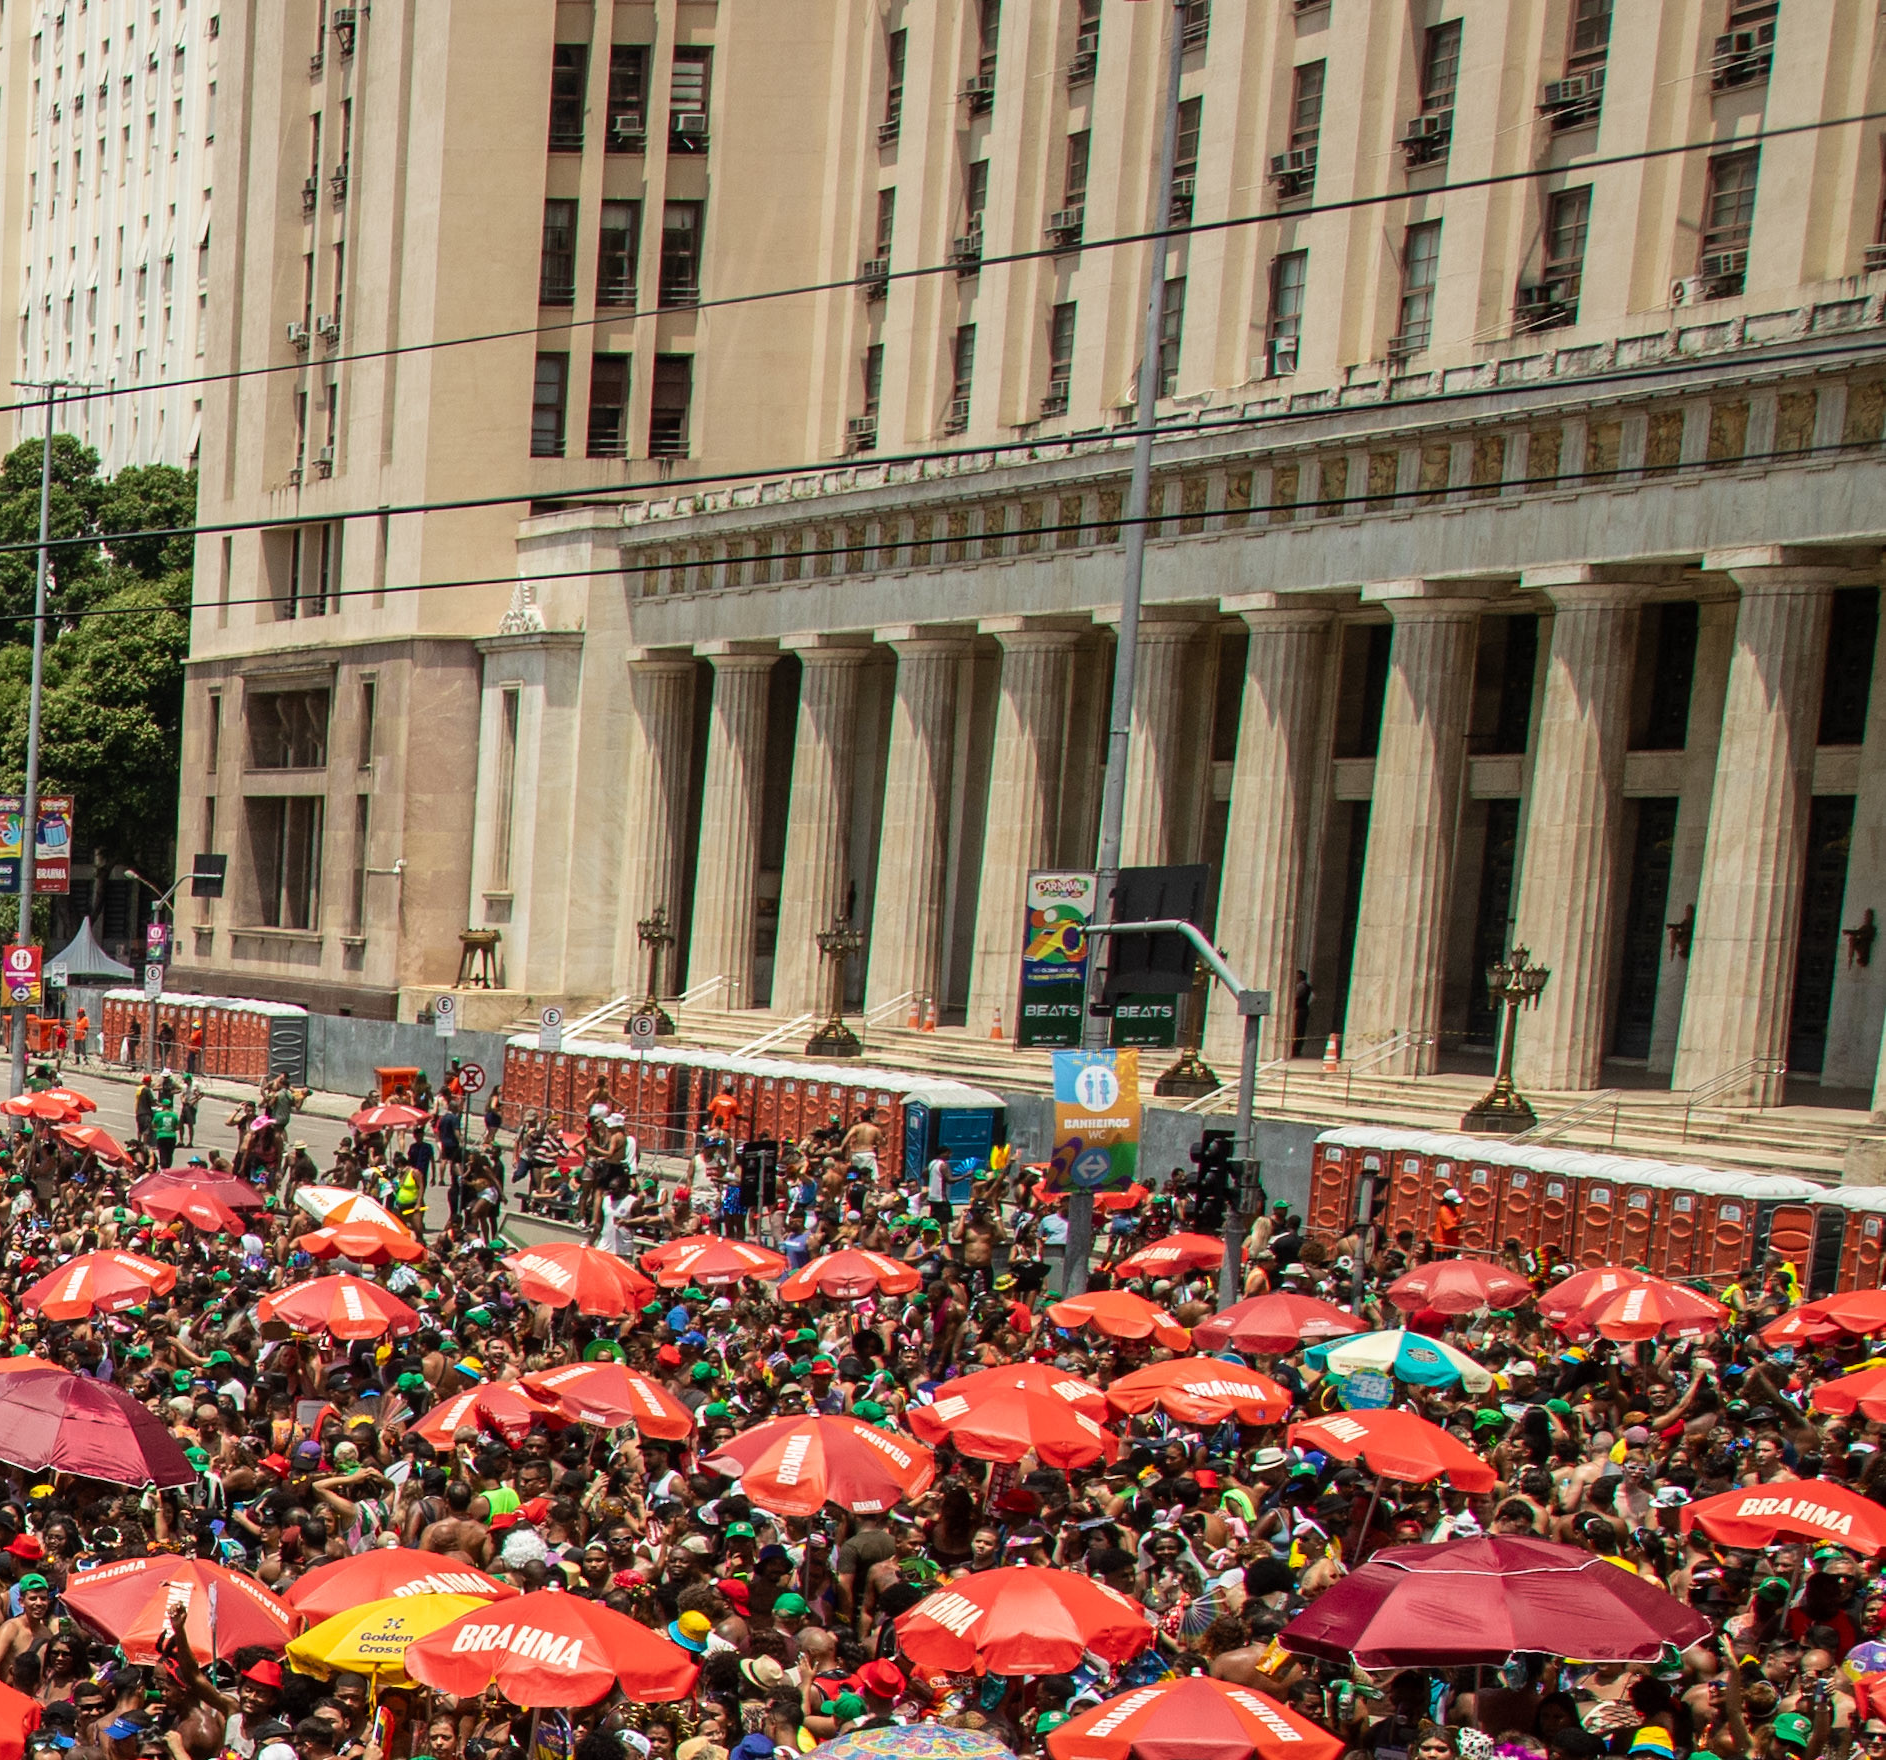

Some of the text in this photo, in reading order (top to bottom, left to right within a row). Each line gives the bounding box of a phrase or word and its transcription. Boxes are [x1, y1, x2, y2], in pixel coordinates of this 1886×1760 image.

[37, 868, 66, 879] BRAHMA
[1036, 879, 1088, 893] CARNAVAL
[1025, 1005, 1080, 1017] BEATS
[1117, 1005, 1172, 1018] BEATS
[1088, 1130, 1106, 1139] WC
[309, 1192, 330, 1208] vivo
[63, 1264, 91, 1301] BRAHMA
[518, 1254, 572, 1288] BRAHMA
[270, 1280, 316, 1306] BRAHMA
[341, 1286, 361, 1321] BRAHMA
[541, 1366, 596, 1387] BRAHMA
[629, 1378, 667, 1417] BRAHMA
[1181, 1382, 1267, 1402] BRAHMA
[440, 1394, 478, 1430] BRAHMA
[778, 1435, 811, 1486] BRAHMA
[853, 1425, 911, 1469] BRAHMA
[1736, 1497, 1855, 1536] BRAHMA
[73, 1558, 147, 1588] BRAHMA
[358, 1644, 403, 1654] Cross
[360, 1632, 414, 1642] Golden
[452, 1623, 583, 1669] BRAHMA
[1087, 1688, 1165, 1740] BRAHMA
[1224, 1688, 1305, 1742] BRAHMA
